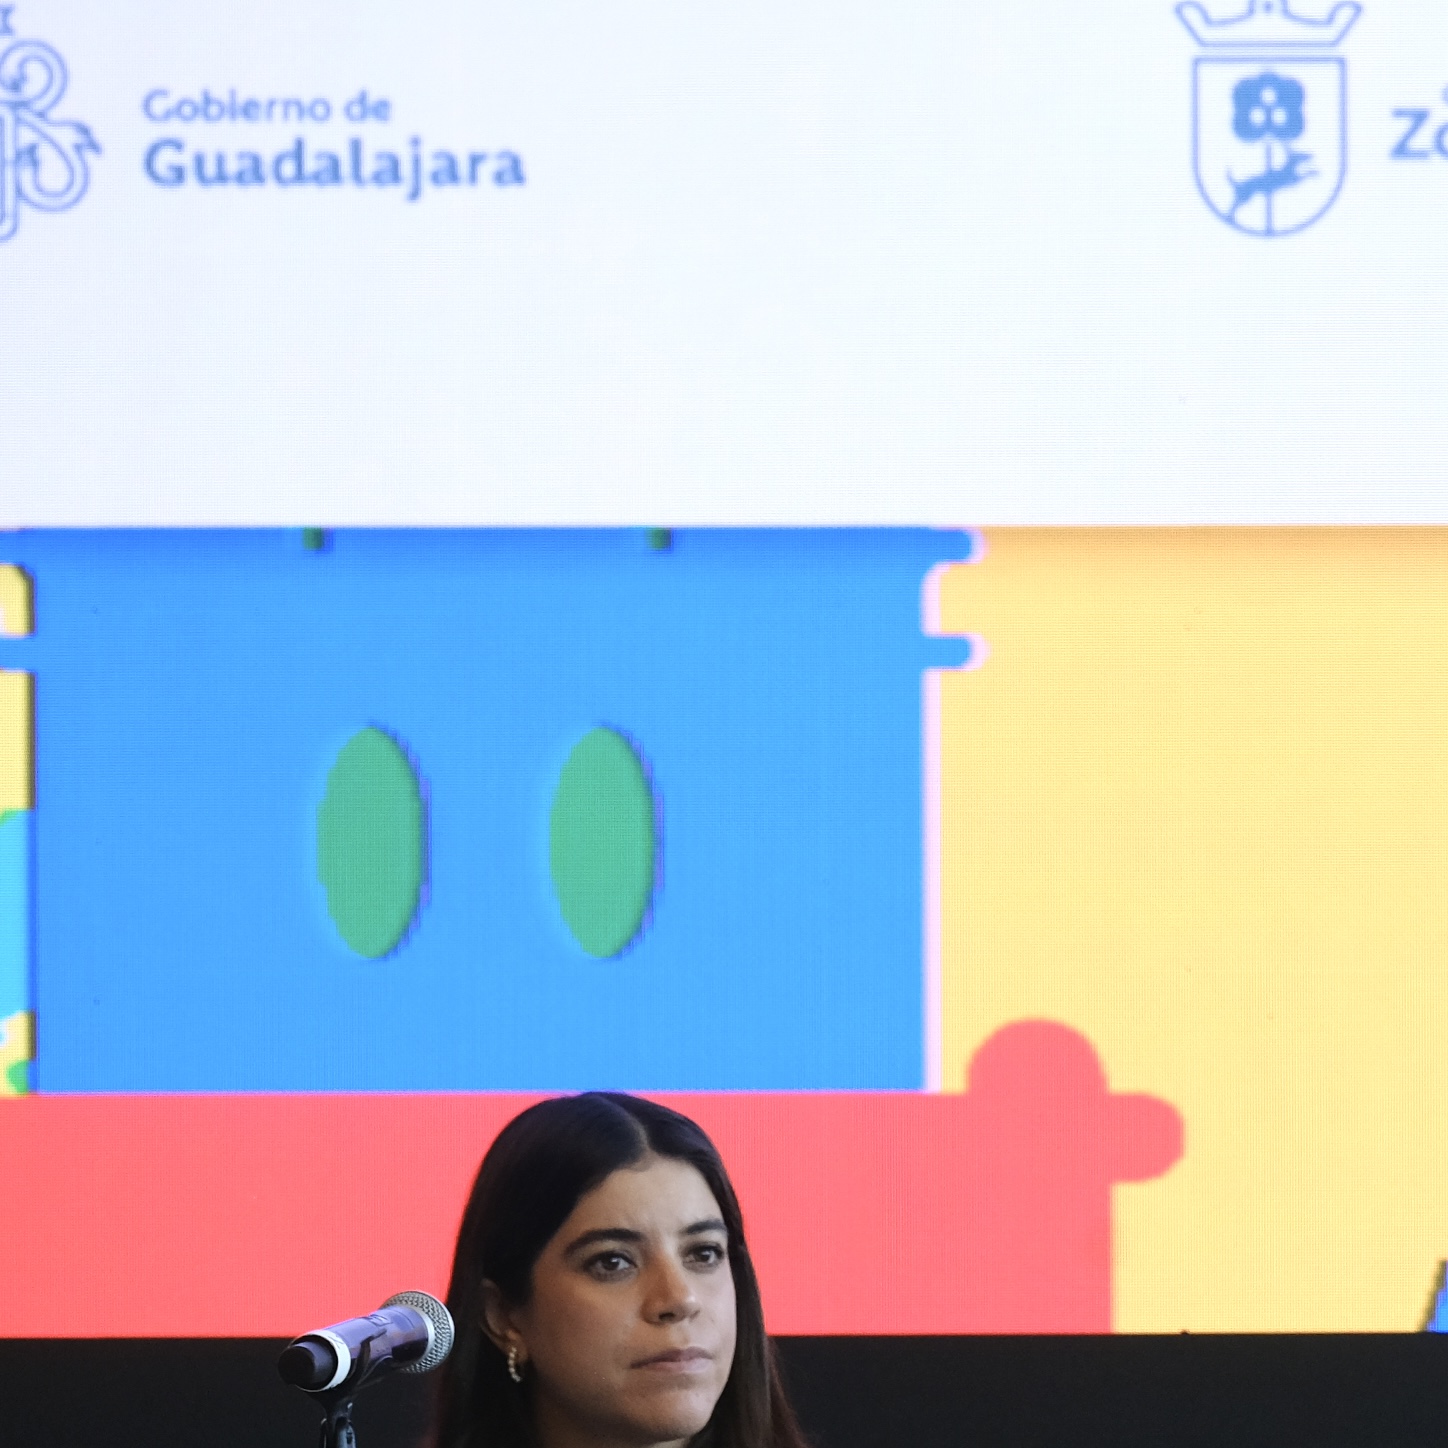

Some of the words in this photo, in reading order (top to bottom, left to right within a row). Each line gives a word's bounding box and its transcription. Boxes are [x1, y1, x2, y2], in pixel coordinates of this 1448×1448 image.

[142, 88, 332, 123] Gobierno
[344, 88, 391, 122] de
[143, 137, 527, 202] Guadalajara
